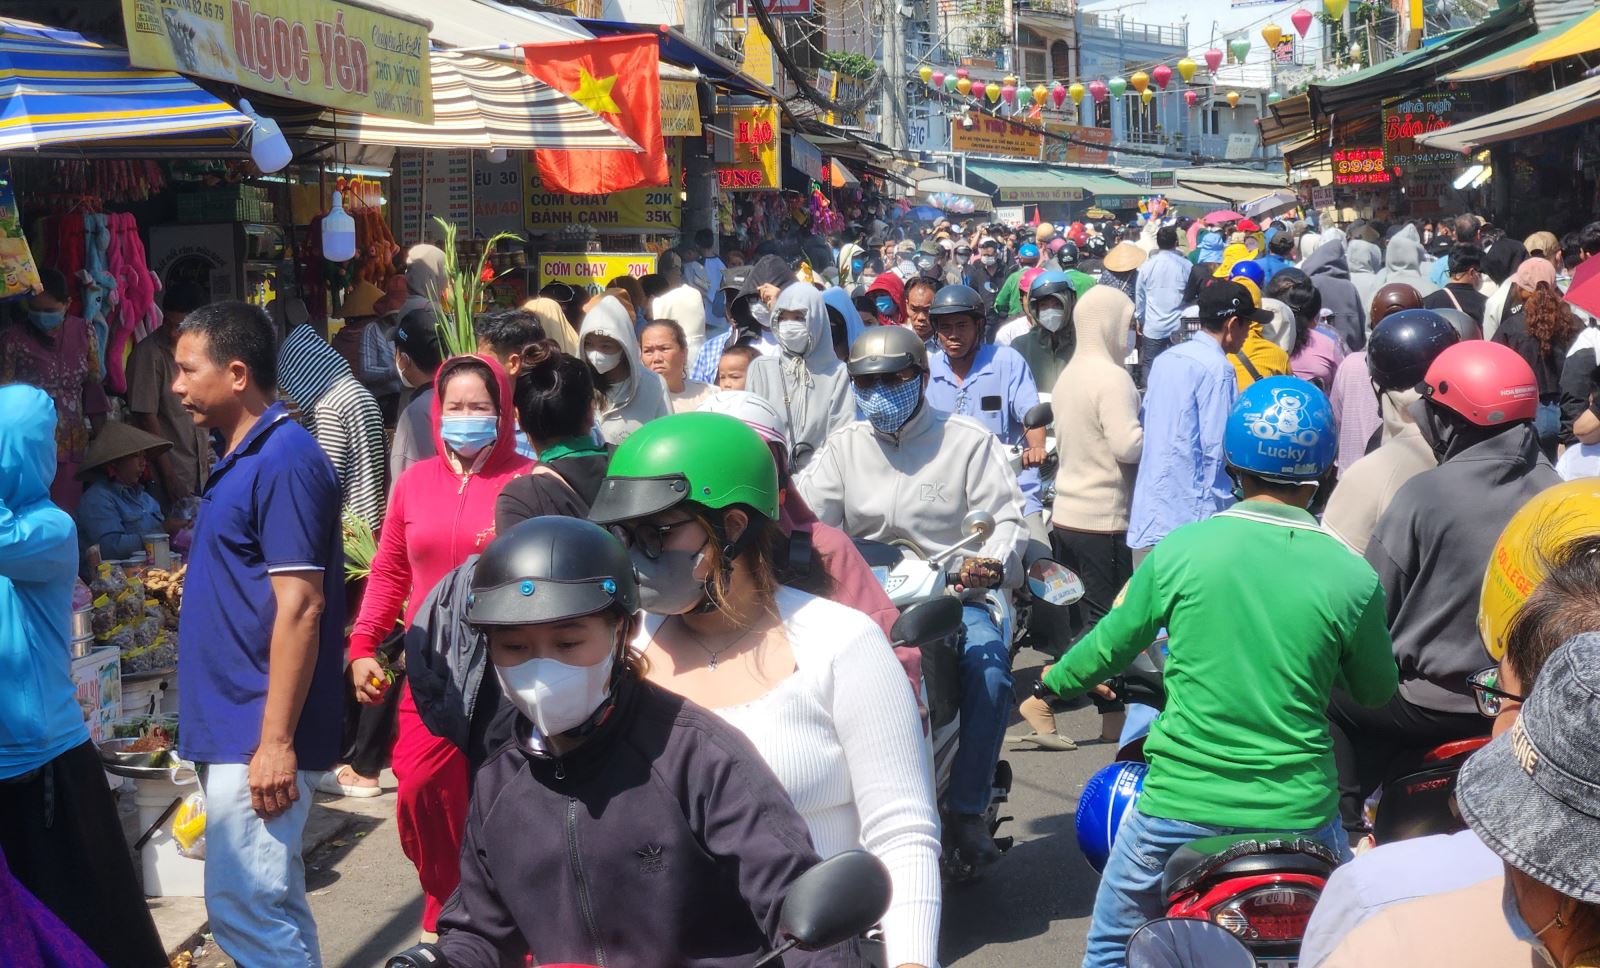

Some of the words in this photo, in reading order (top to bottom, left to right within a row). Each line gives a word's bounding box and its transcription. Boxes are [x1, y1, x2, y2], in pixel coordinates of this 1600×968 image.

[231, 0, 311, 94] Ngọc
[315, 10, 369, 96] Yến
[499, 171, 518, 185] 30
[718, 168, 763, 187] UNG
[499, 200, 519, 215] 40
[645, 193, 673, 205] 20K
[578, 211, 619, 224] CANH
[645, 210, 673, 223] 35K
[544, 260, 571, 276] CƠM
[575, 263, 607, 277] CHAY
[628, 263, 649, 277] 20K
[1257, 441, 1306, 461] Lucky
[1496, 546, 1534, 598] COLLEGE
